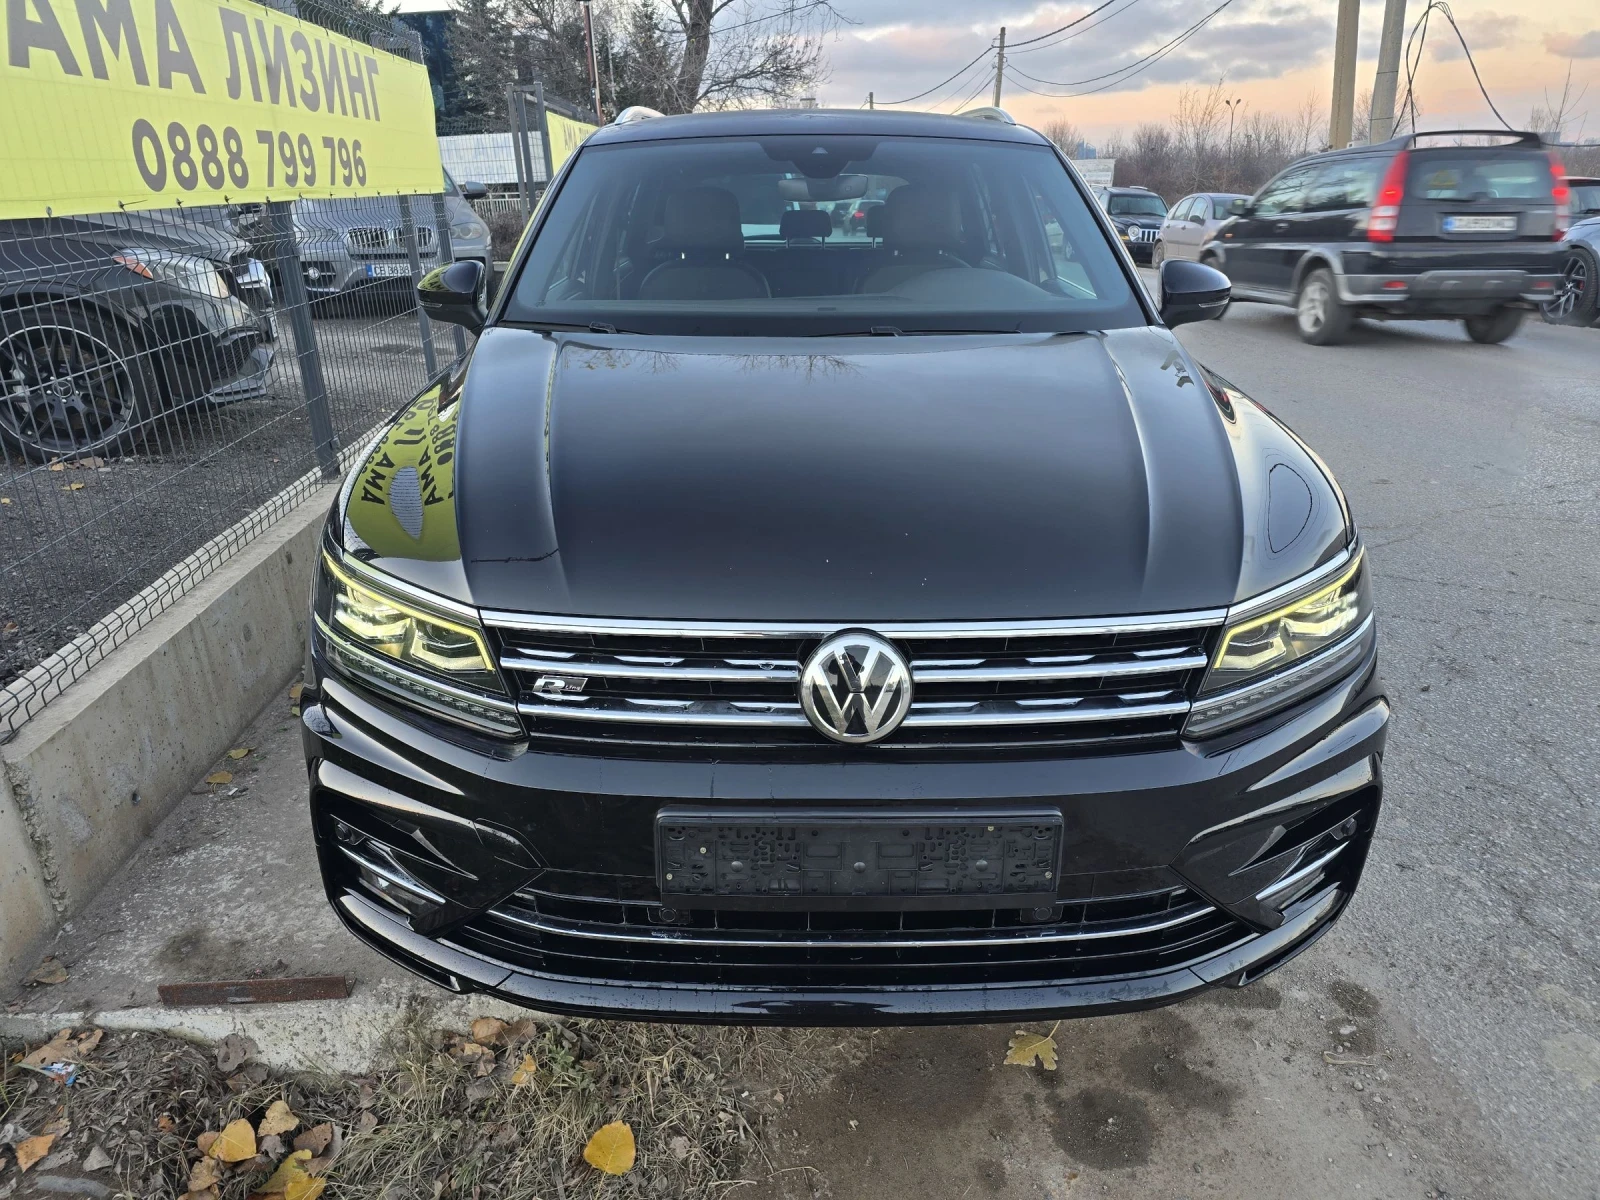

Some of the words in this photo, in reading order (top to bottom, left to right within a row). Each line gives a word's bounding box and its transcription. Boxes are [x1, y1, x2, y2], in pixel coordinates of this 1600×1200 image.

[8, 0, 207, 94] АМА
[218, 6, 381, 122] ЛИЗИНГ
[132, 118, 250, 192] 0888
[256, 129, 317, 188] 799
[322, 136, 367, 188] 796
